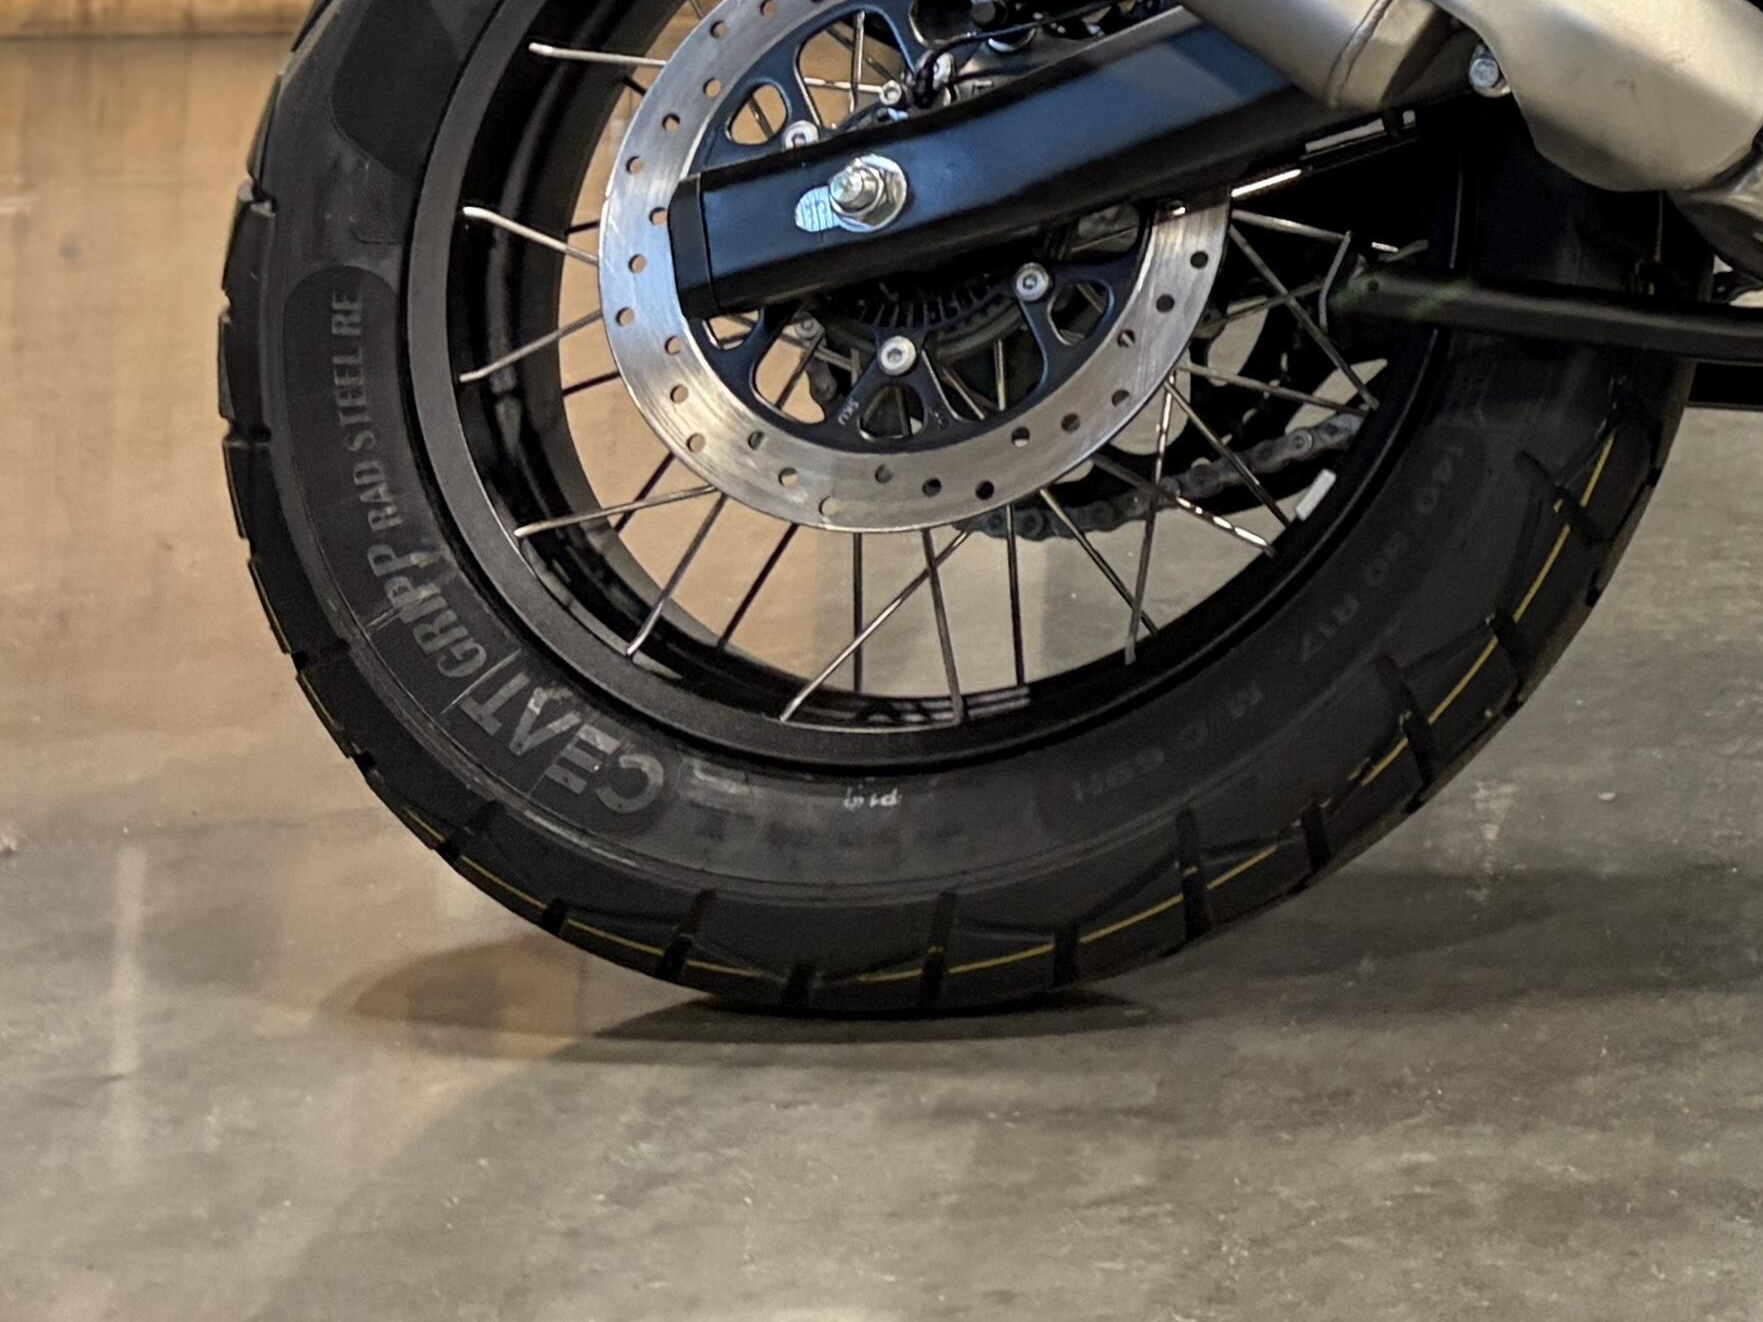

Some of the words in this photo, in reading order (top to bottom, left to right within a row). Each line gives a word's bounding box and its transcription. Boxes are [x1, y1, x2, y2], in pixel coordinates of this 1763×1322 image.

[333, 346, 378, 453] STEEL
[352, 459, 403, 533] RAD
[367, 544, 487, 678] GRIPP
[460, 672, 665, 814] CEAT
